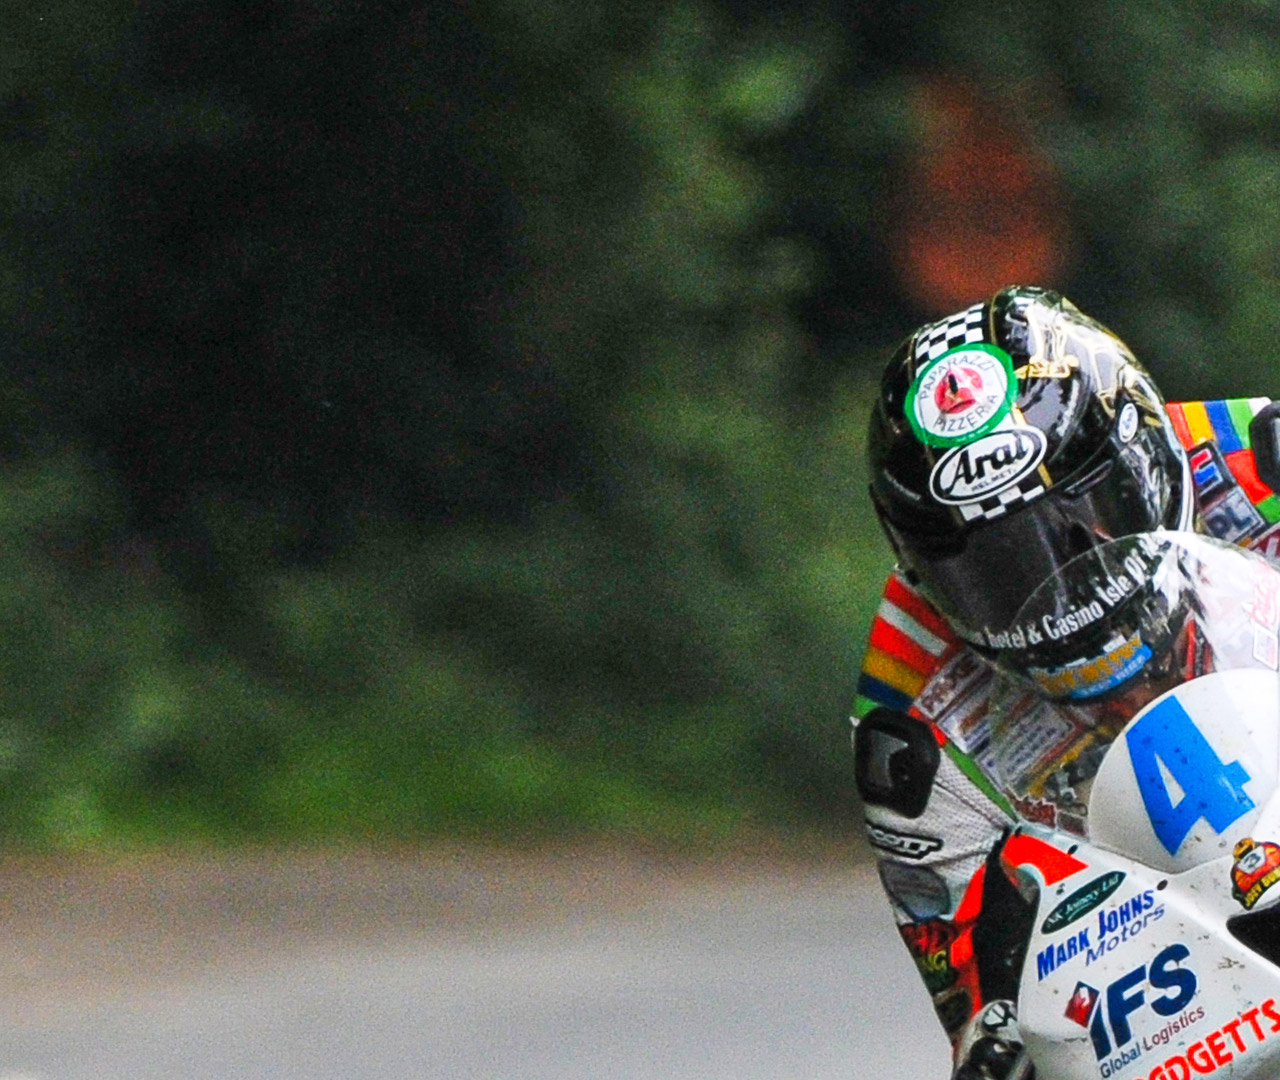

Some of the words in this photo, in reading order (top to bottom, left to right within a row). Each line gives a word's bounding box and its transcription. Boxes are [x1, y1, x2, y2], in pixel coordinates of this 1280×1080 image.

[941, 431, 1029, 497] Arai
[1042, 601, 1105, 641] Casino
[1126, 695, 1255, 857] 4
[865, 825, 940, 857] COTT
[1036, 927, 1091, 982] MARK
[1097, 889, 1155, 941] JOHNS
[1085, 903, 1166, 967] Motors
[1099, 1041, 1142, 1080] Global
[1142, 1006, 1206, 1053] Logistics
